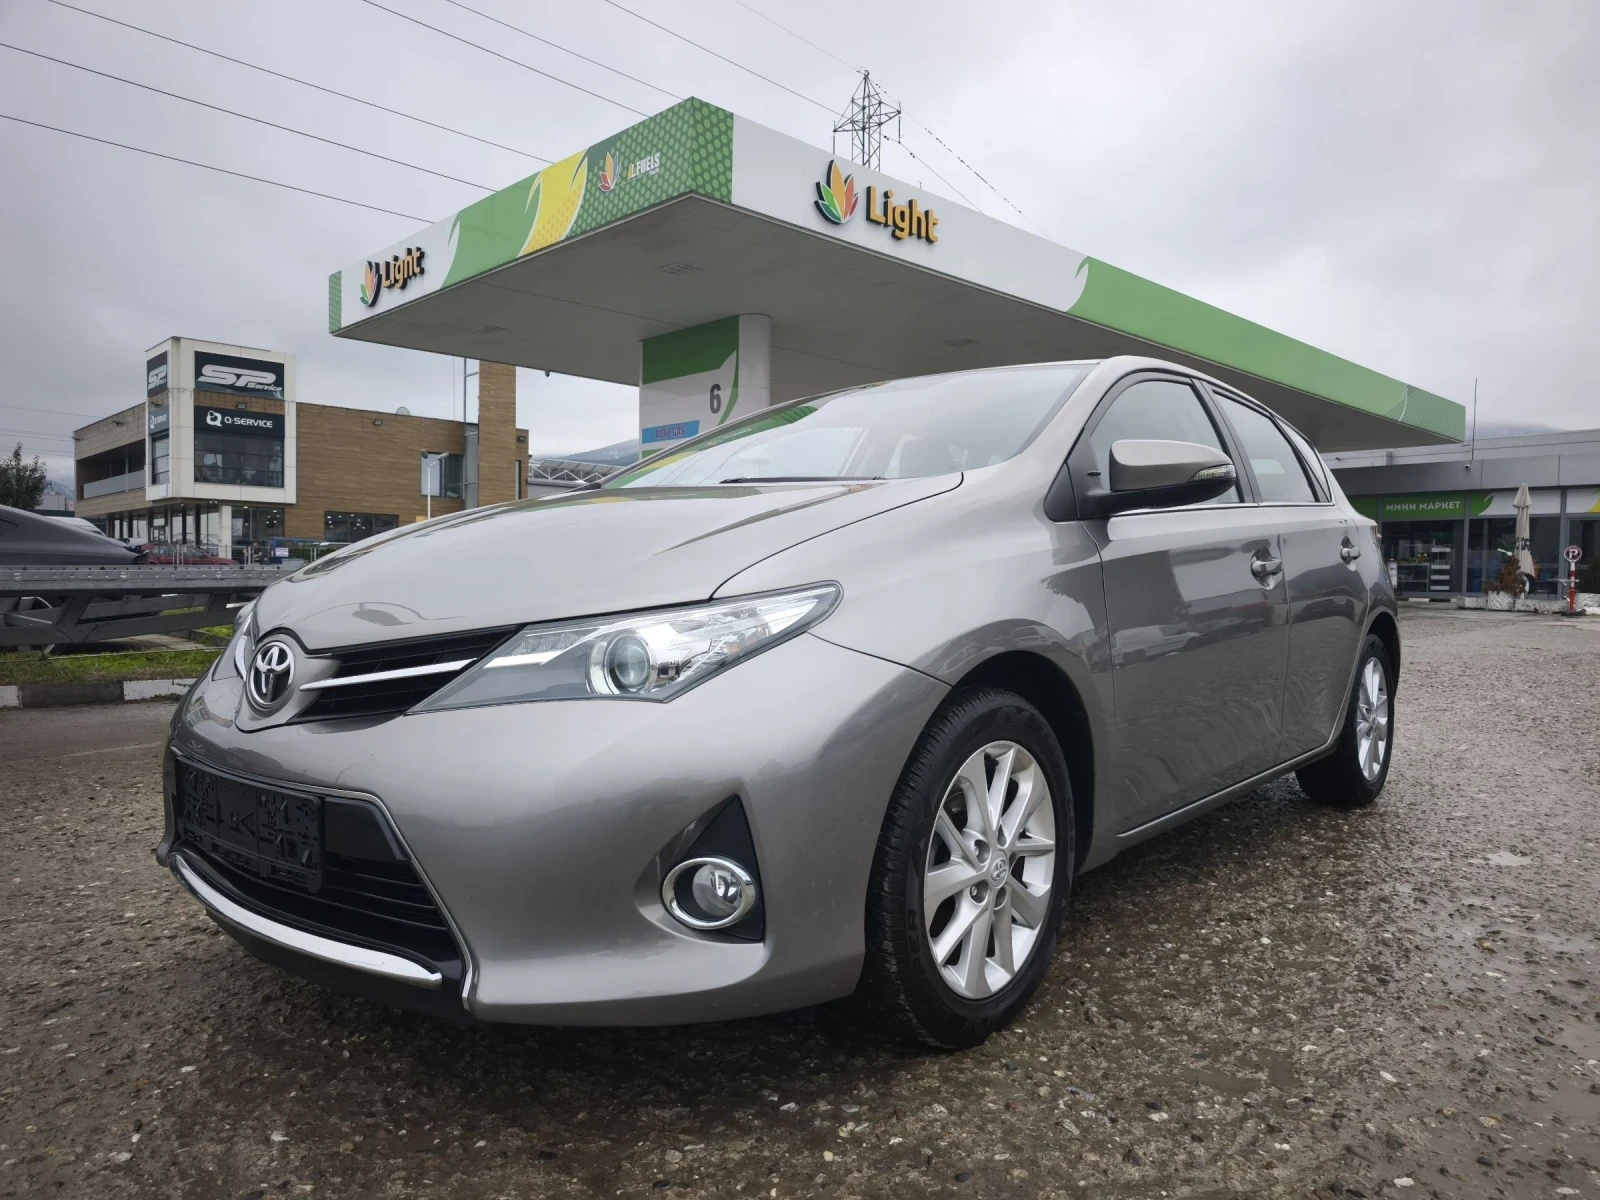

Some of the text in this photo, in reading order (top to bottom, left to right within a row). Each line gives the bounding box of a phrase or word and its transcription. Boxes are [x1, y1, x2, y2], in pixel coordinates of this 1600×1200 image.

[637, 152, 661, 175] FUELS
[866, 185, 939, 244] Light
[381, 246, 425, 289] Light
[197, 364, 277, 387] SP
[246, 382, 283, 391] Service
[710, 384, 722, 414] 6
[656, 426, 685, 439] AUTO GAS
[1386, 501, 1461, 512] МИНИ МАРКЕТ
